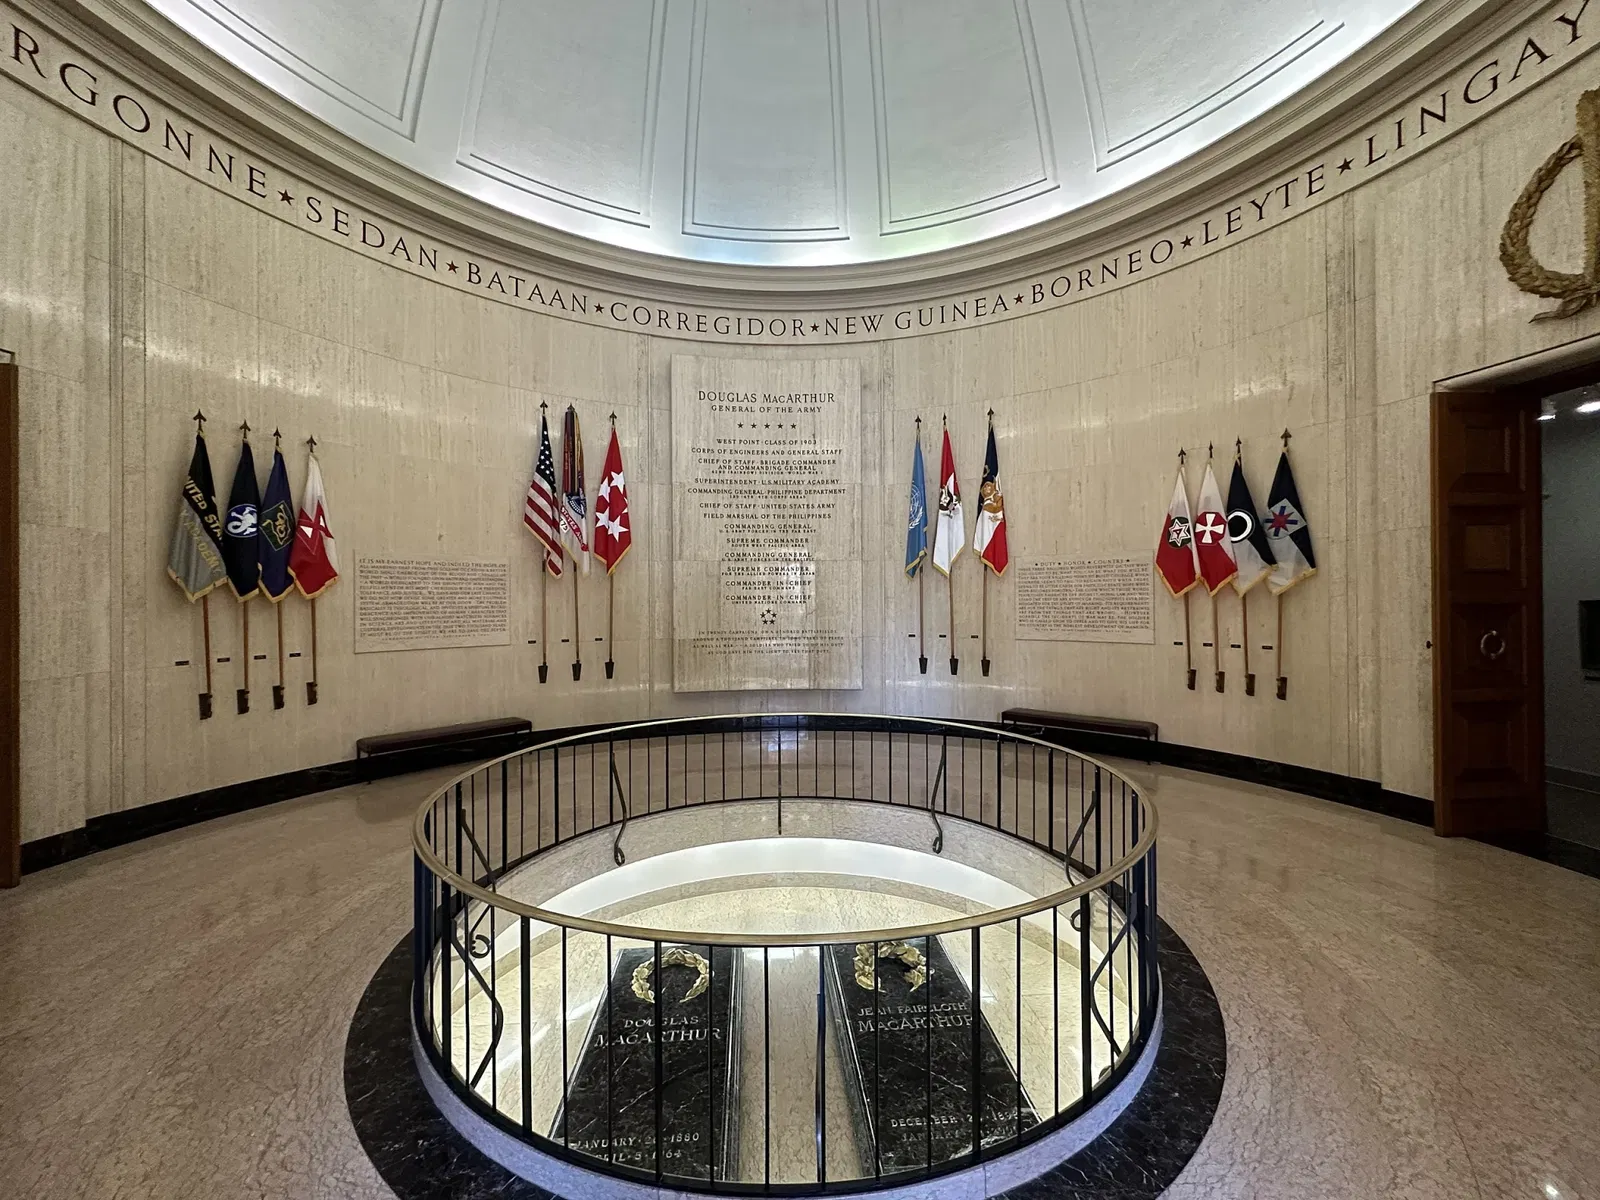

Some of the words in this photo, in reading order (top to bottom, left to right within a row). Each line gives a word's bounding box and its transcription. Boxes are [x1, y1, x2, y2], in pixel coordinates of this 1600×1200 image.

[0, 22, 268, 199] RGONNE
[305, 195, 439, 273] SEDAN
[466, 261, 589, 315] BATAAN
[609, 301, 806, 338] CORREGIDOR
[824, 312, 885, 337] NEW
[895, 294, 1011, 332] GUINEA
[1029, 238, 1175, 305] BORNEO
[1201, 162, 1326, 247] LEYTE
[698, 390, 757, 403] DOUGLAS
[711, 404, 756, 412] GENERAL
[670, 1132, 700, 1143] 1880
[634, 1152, 642, 1160] 5
